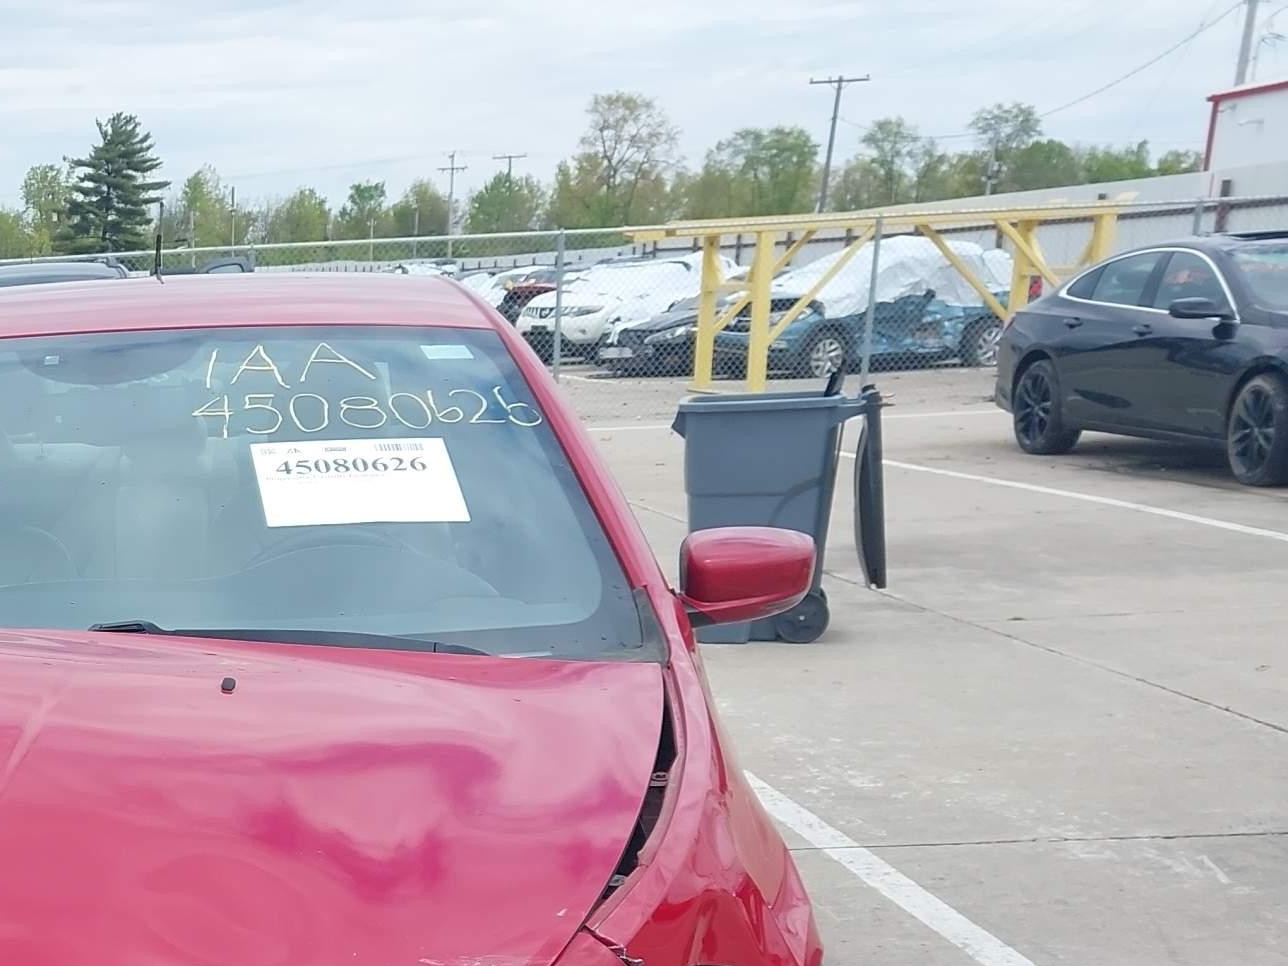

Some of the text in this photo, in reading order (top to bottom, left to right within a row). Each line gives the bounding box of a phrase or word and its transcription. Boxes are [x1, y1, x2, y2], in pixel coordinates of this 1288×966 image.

[206, 342, 377, 390] IAA
[191, 386, 543, 439] 45080626
[275, 456, 428, 476] 45080626
